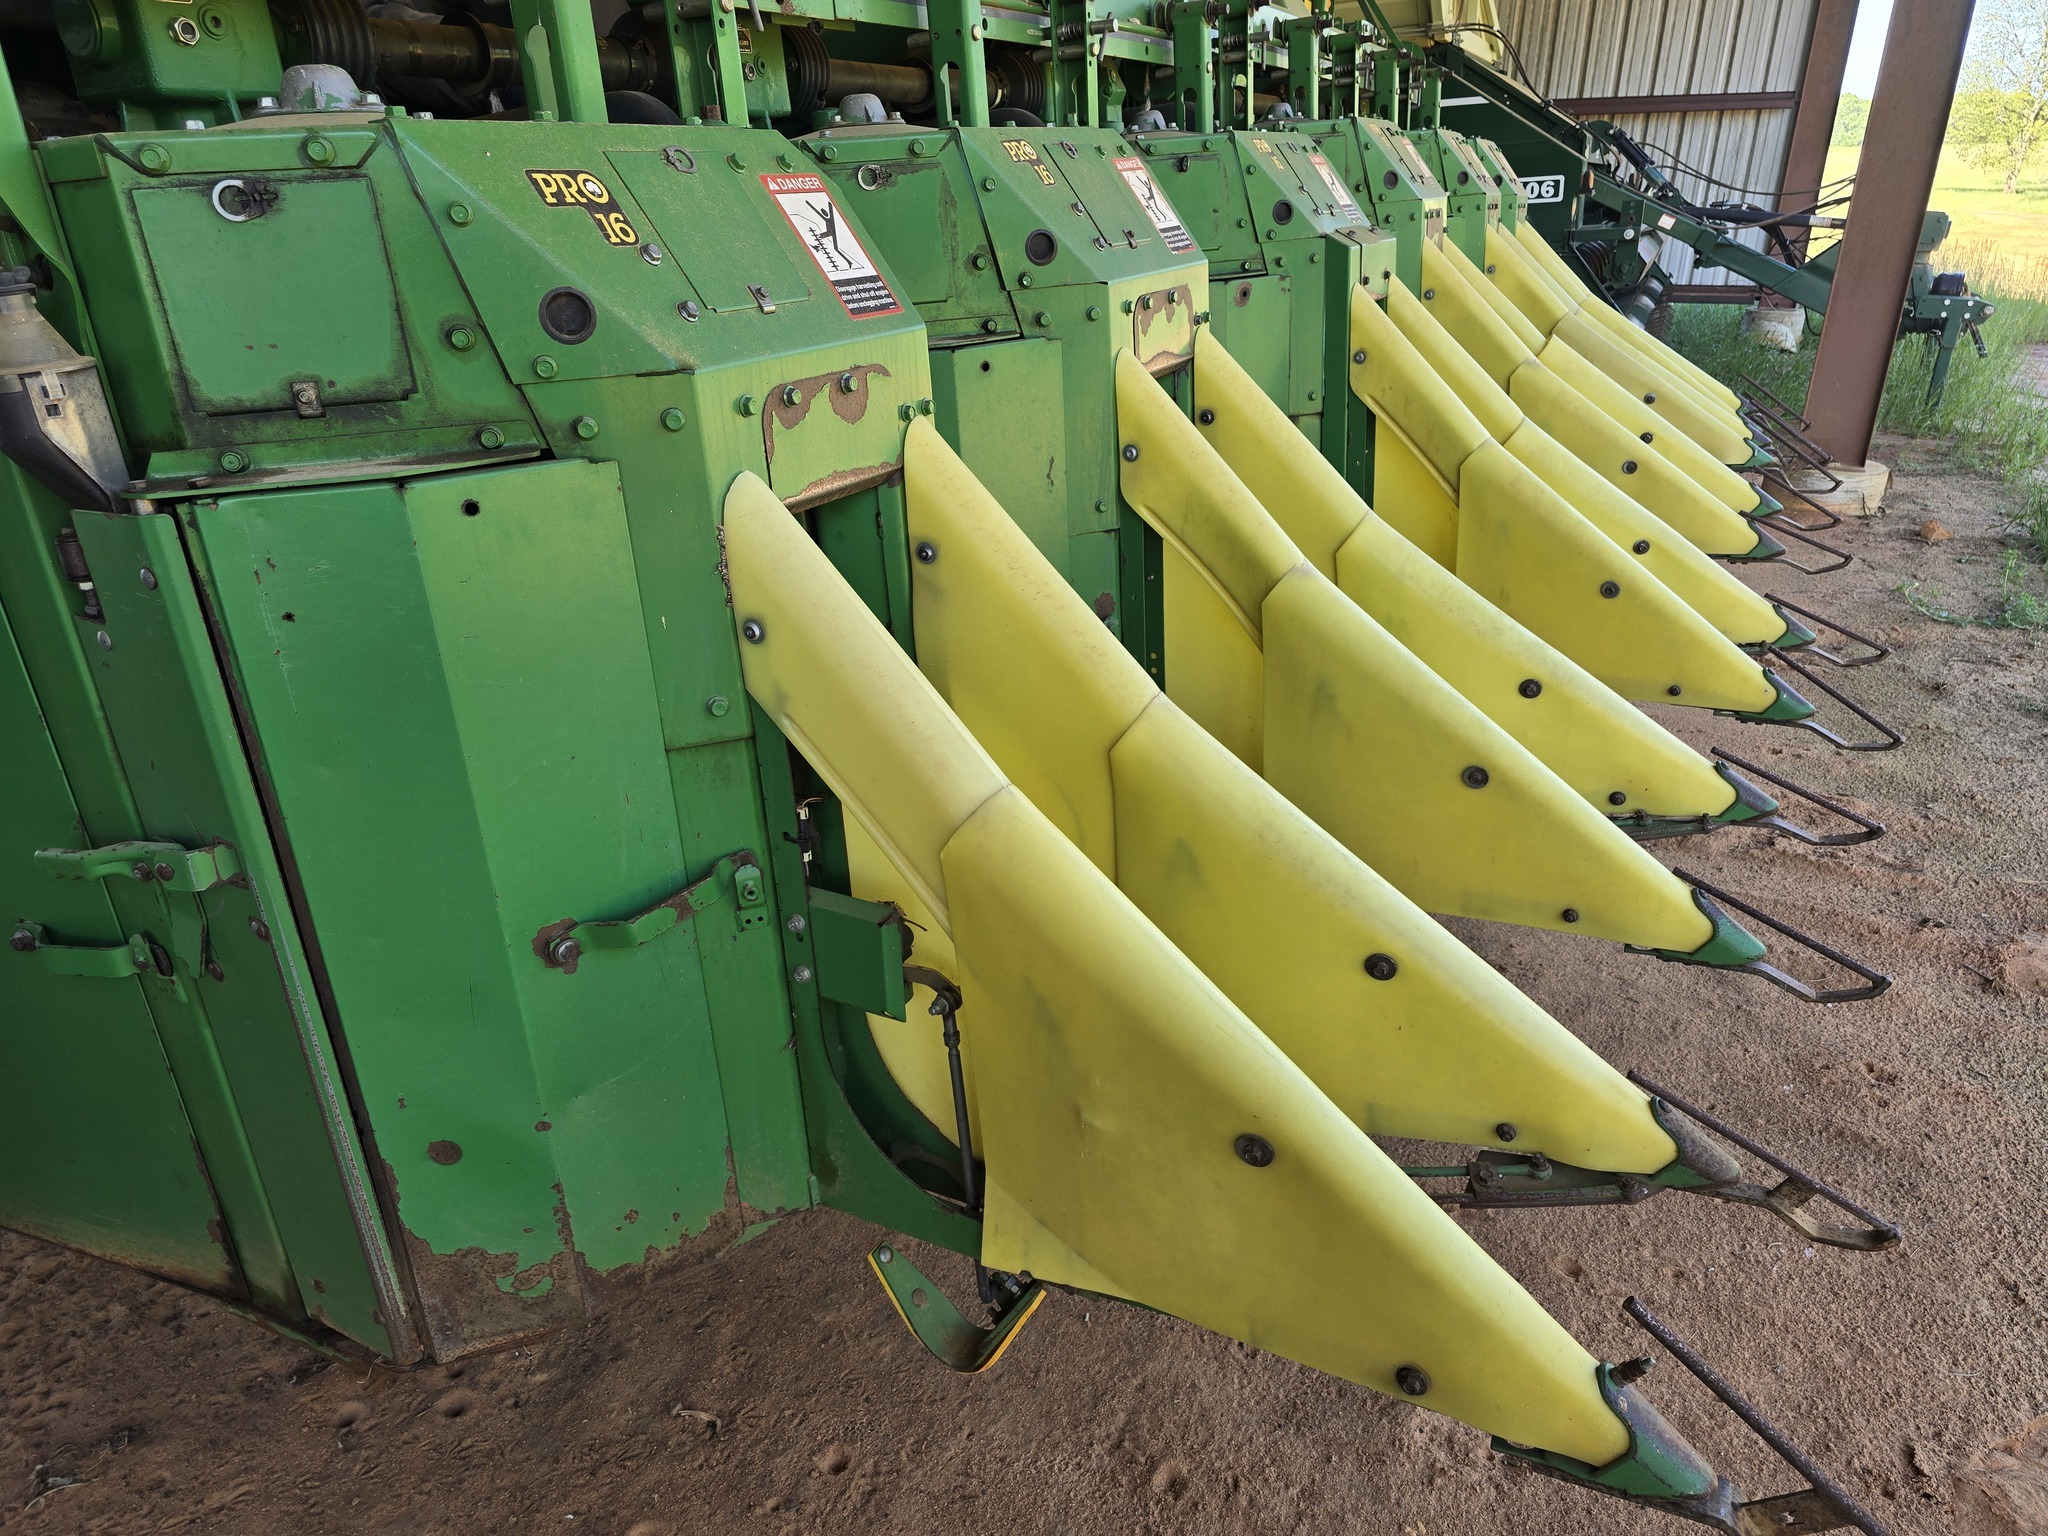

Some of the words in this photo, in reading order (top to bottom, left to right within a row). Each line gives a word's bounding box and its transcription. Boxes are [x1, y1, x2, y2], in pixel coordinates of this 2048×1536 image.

[1002, 140, 1038, 161] PRO
[776, 177, 823, 190] DANGER
[1033, 164, 1055, 184] 16
[531, 173, 609, 204] PRO
[1521, 180, 1555, 199] 06
[594, 212, 636, 243] 16
